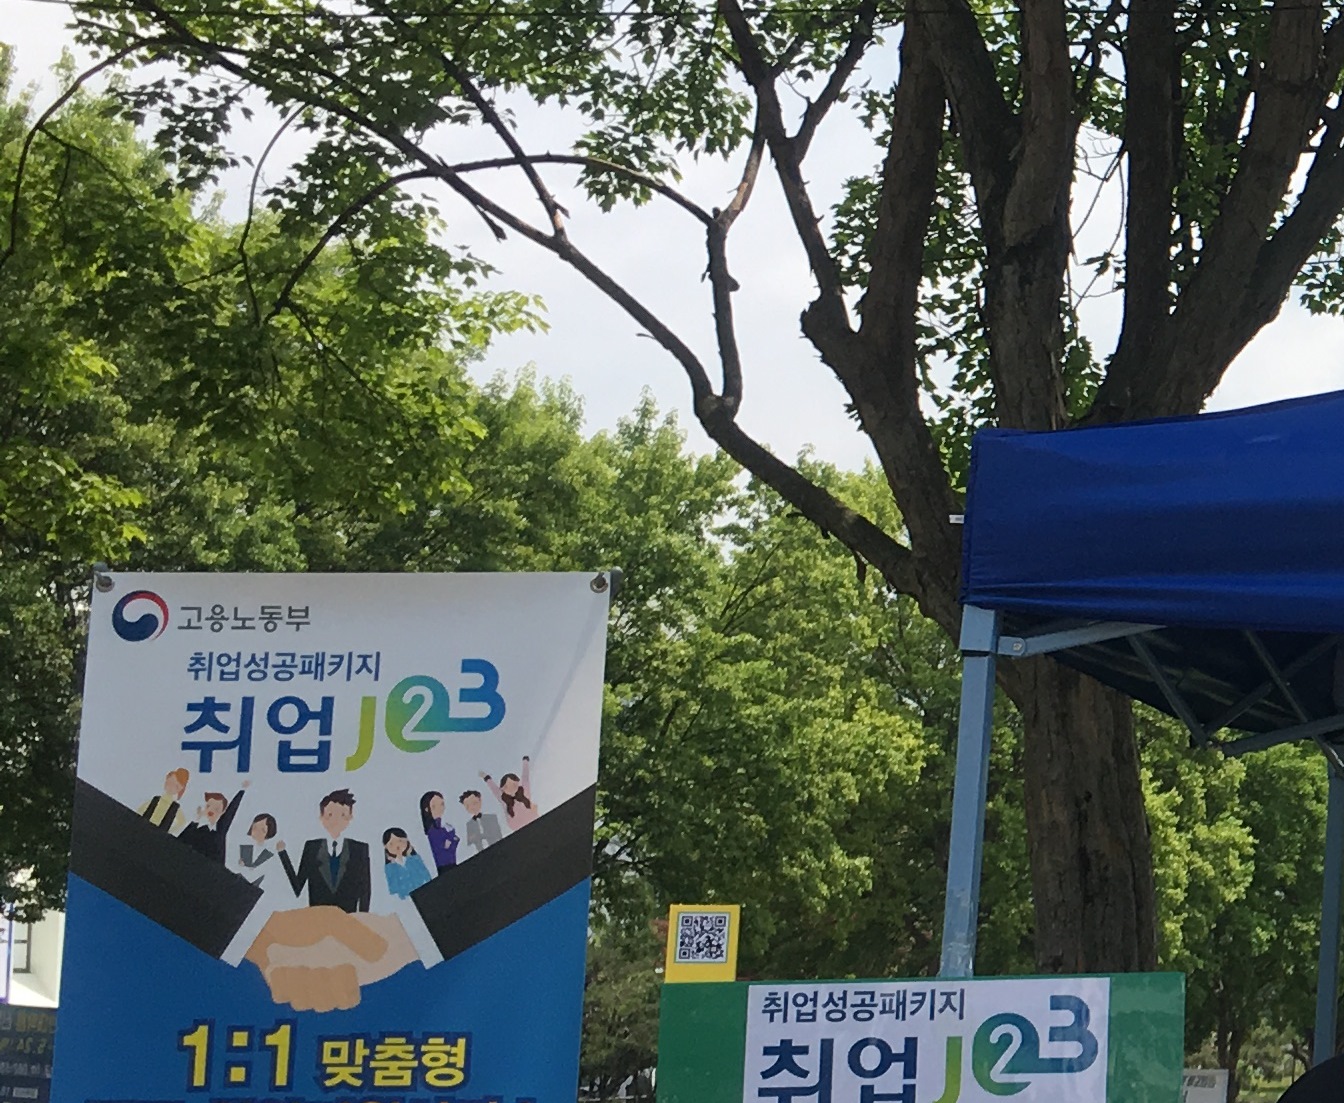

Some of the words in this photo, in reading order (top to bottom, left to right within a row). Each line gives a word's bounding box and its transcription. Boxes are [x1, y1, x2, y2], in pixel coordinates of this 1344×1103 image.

[178, 605, 311, 632] 고용노동부
[186, 651, 382, 682] 취업성공패키지
[180, 696, 334, 773] 취업
[761, 988, 966, 1024] 취업성공패키지
[181, 1024, 293, 1087] 1:1
[321, 1036, 468, 1086] 맞춤형
